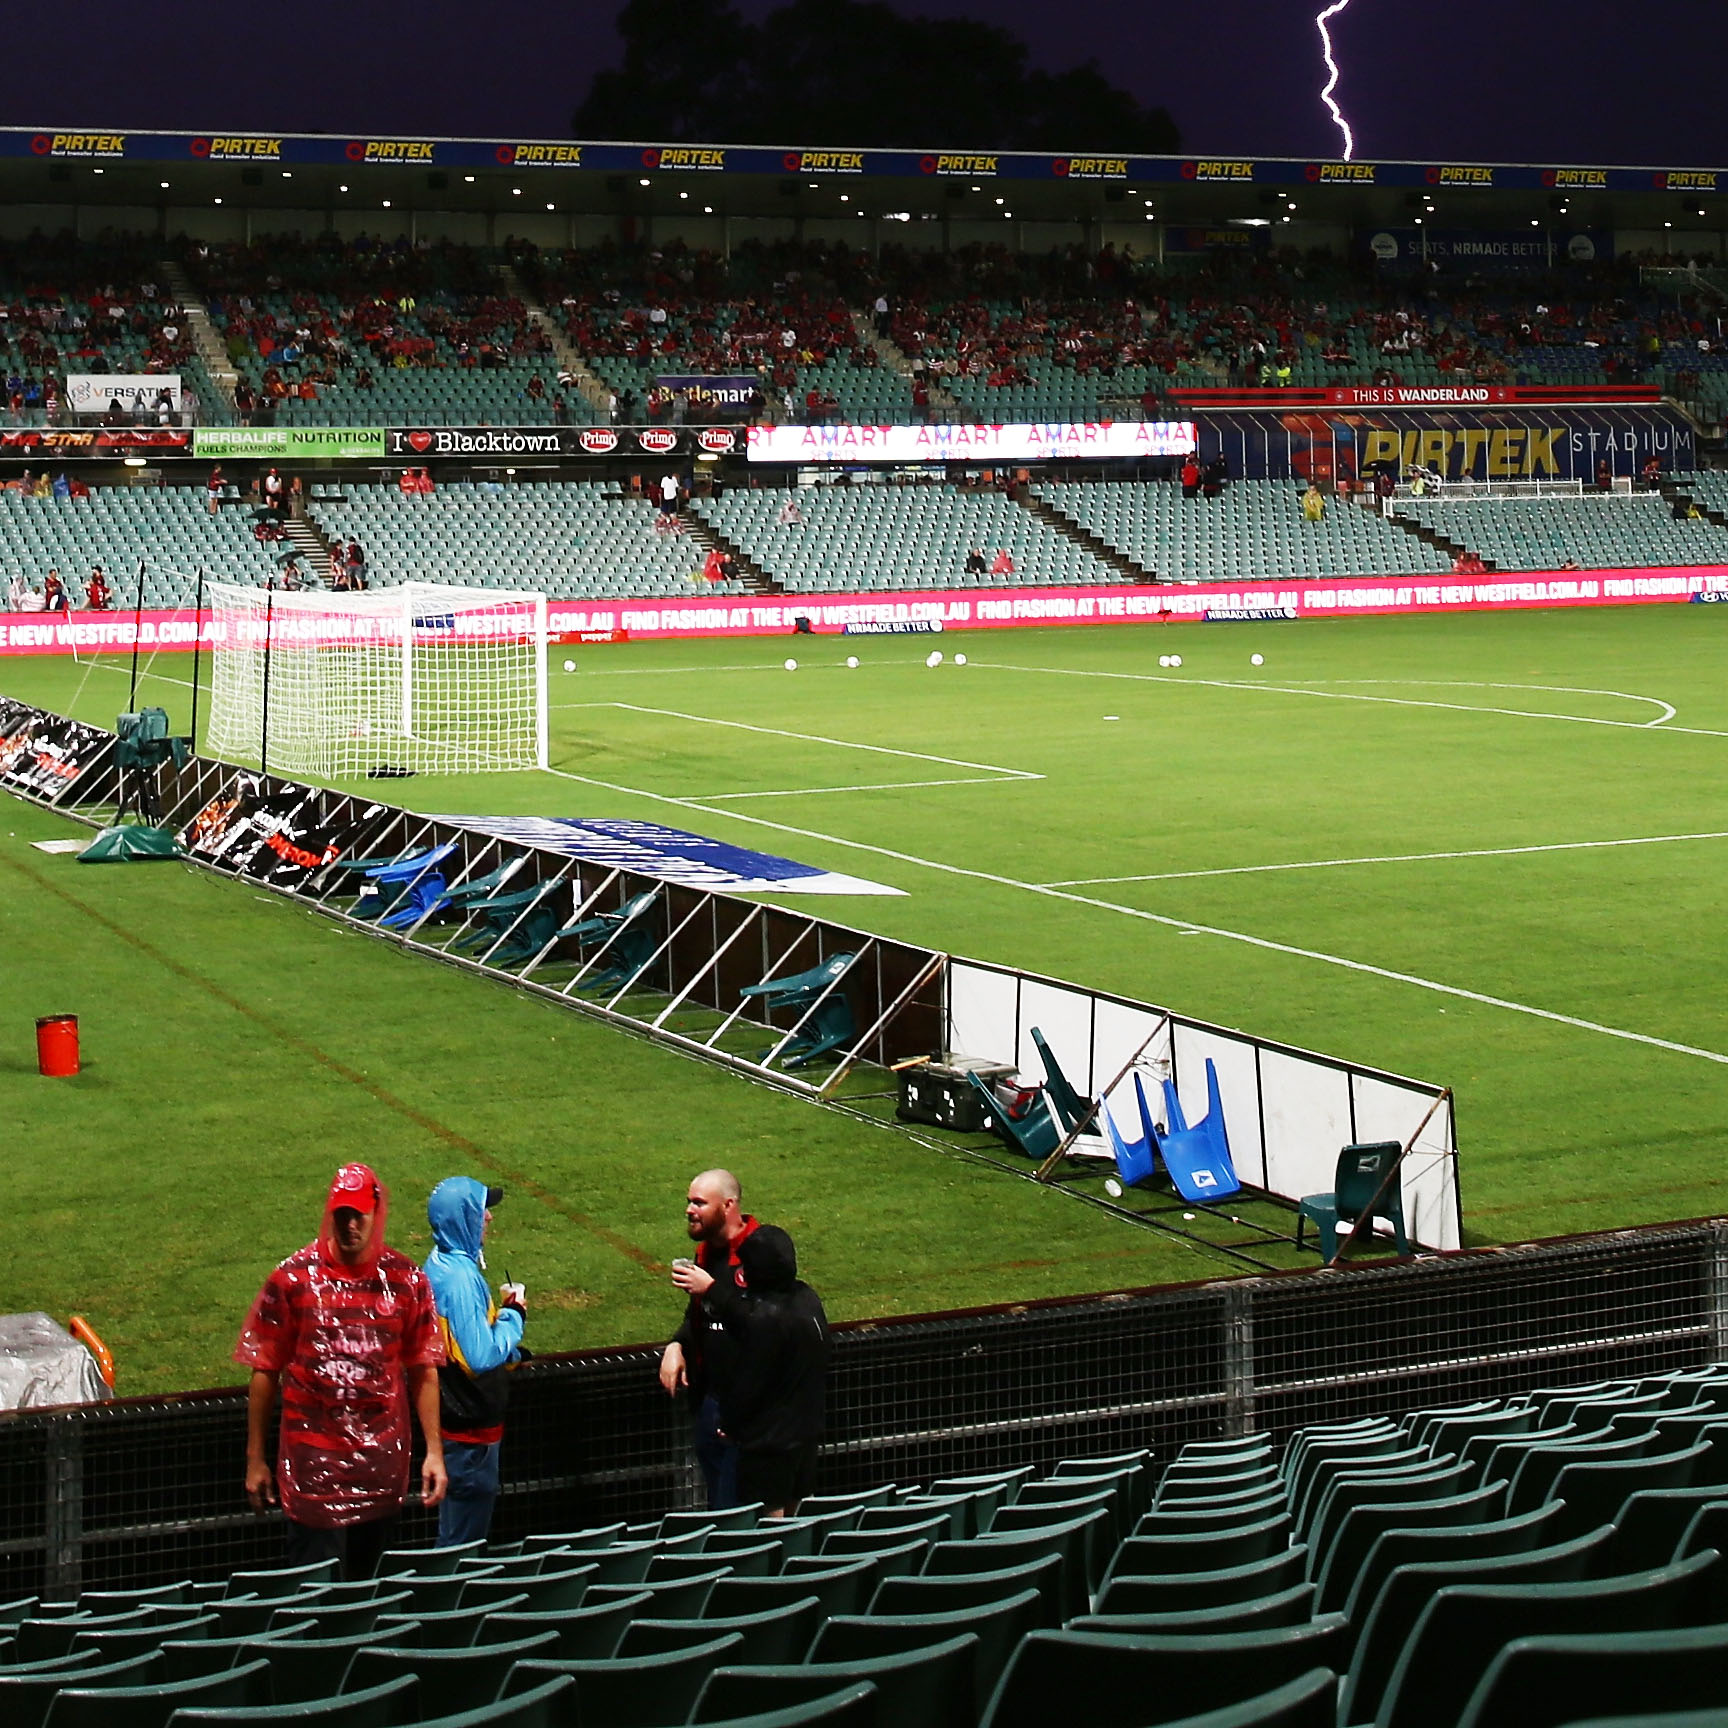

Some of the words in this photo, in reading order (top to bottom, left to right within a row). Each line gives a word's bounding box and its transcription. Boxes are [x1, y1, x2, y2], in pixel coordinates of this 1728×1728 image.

[54, 136, 125, 151] PIRTEK
[213, 139, 281, 155] PIRTEK
[367, 143, 433, 158] PIRTEK
[517, 147, 581, 161] PIRTEK
[662, 150, 724, 165] PIRTEK
[803, 154, 863, 168] PIRTEK
[939, 157, 998, 171] PIRTEK
[1070, 160, 1127, 174] PIRTEK
[1198, 163, 1253, 177] PIRTEK
[1322, 165, 1374, 179] PIRTEK
[1441, 169, 1492, 181] PIRTEK
[1557, 171, 1606, 184] PIRTEK
[1668, 174, 1716, 186] PIRTEK
[1452, 241, 1509, 256] NRMADE
[93, 387, 177, 397] VERSATIE
[1353, 389, 1380, 403] THIS
[1383, 389, 1395, 402] IS
[1398, 388, 1489, 402] WANDERLAND
[196, 432, 287, 444] HERBALIFE
[292, 431, 381, 444] NUTRITION
[582, 433, 616, 446] Primo
[641, 433, 675, 446] Primo
[700, 432, 733, 445] Primo
[801, 426, 893, 447] AMART
[915, 425, 1003, 446] AMART
[1027, 423, 1113, 444] AMART
[393, 431, 403, 452] I
[435, 430, 561, 452] Blacktown
[196, 445, 223, 454] FUELS
[224, 445, 287, 454] CHAMPIONS
[1361, 428, 1567, 478] PIRTEK
[1572, 429, 1692, 452] STADIUM
[1603, 579, 1633, 597] FIND
[1633, 577, 1688, 596] FASHION
[1687, 576, 1704, 594] AT
[1303, 590, 1336, 608] FIND
[1336, 588, 1394, 607] FASHION
[1394, 587, 1413, 606] AT
[1412, 586, 1441, 605] THE
[1440, 585, 1474, 603] NEW
[1474, 580, 1599, 603] WESTFIELD.COM.AU
[976, 600, 1012, 619] FIND
[1013, 598, 1076, 618] FASHION
[1076, 598, 1096, 617] AT
[1095, 597, 1126, 616] THE
[1125, 595, 1162, 615] NEW
[1207, 610, 1251, 620] NRMADE
[1250, 608, 1285, 619] BETTER
[622, 611, 659, 630] FIND
[660, 609, 729, 629] FASHION
[729, 608, 751, 628] AT
[750, 607, 783, 627] THE
[822, 602, 971, 625] WESTFIELD.COM.AU
[236, 621, 277, 641] FIND
[278, 619, 350, 640] FASHION
[352, 619, 374, 638] AT
[846, 623, 893, 634] NRMADE
[893, 621, 930, 632] BETTER
[10, 624, 55, 646] NEW
